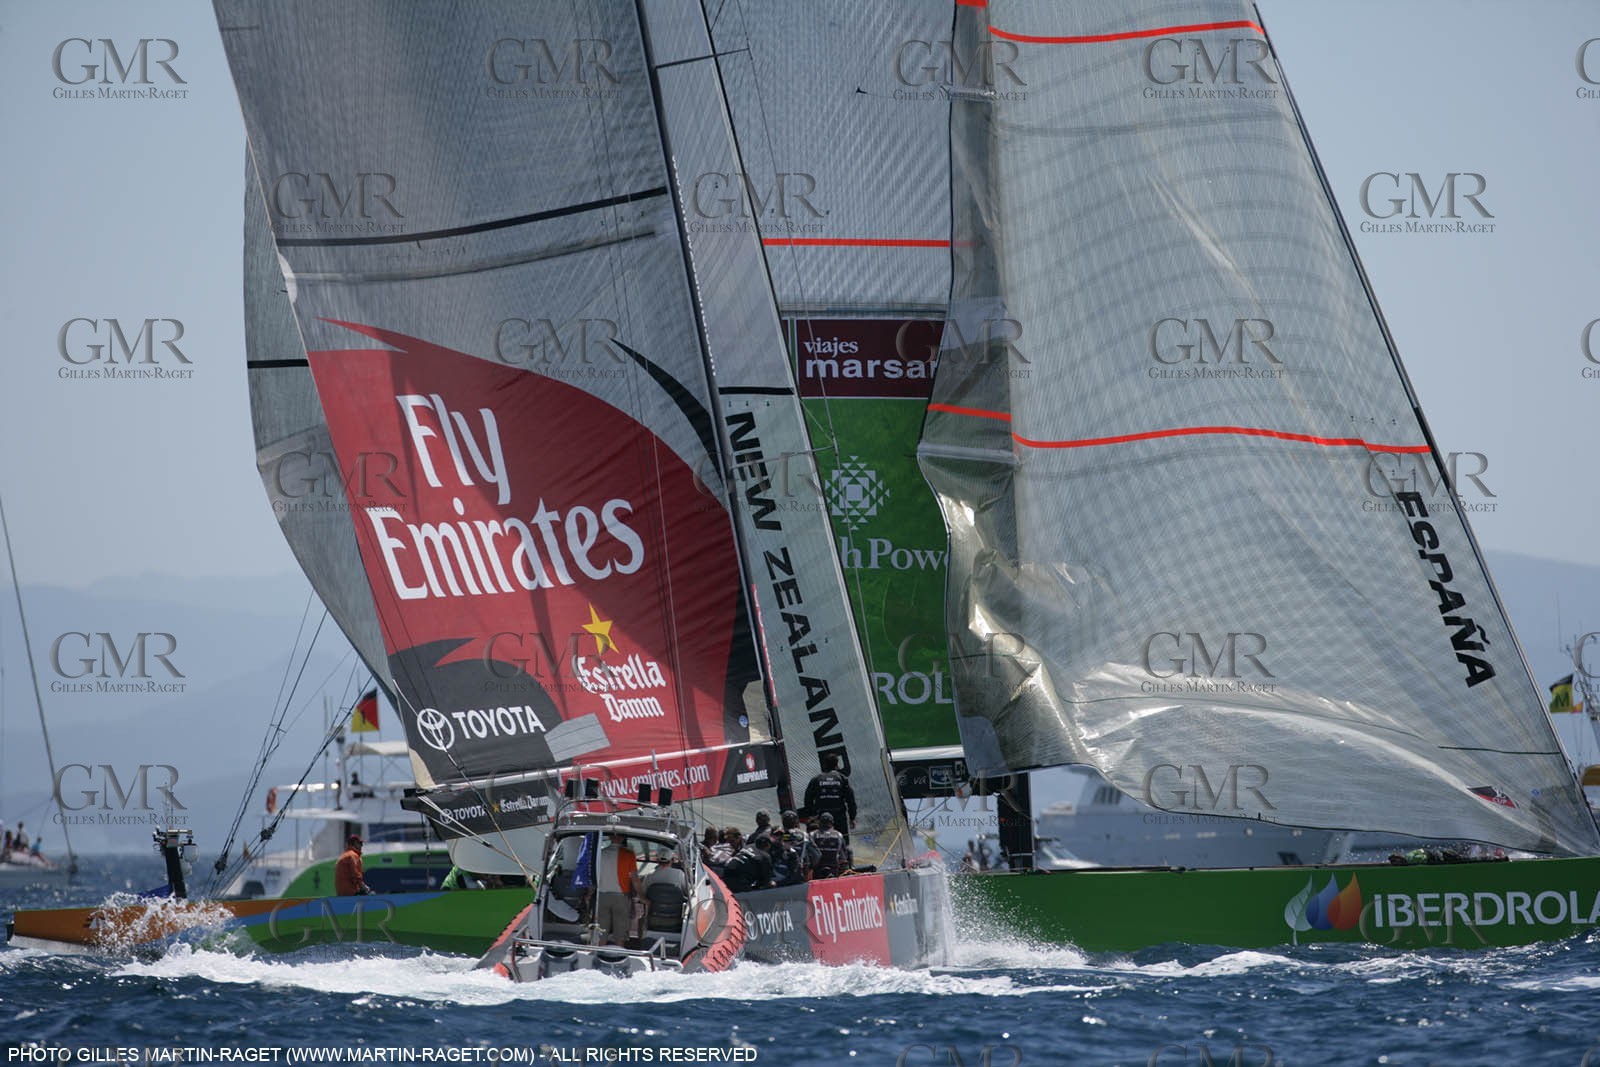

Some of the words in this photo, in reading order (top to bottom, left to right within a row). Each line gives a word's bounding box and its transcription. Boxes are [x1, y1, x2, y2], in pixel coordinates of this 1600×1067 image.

[803, 337, 859, 358] viajes
[395, 392, 512, 505] Fly
[725, 410, 782, 532] NEW
[365, 496, 645, 600] Emirates
[1397, 490, 1496, 688] ESPAÑA
[571, 653, 667, 695] Estrella
[452, 704, 546, 740] TOYOTA
[600, 693, 665, 722] Damm
[453, 803, 486, 821] TOYOTA
[757, 910, 794, 935] TOYOTA
[812, 895, 838, 944] Fly
[833, 889, 883, 933] Emirates
